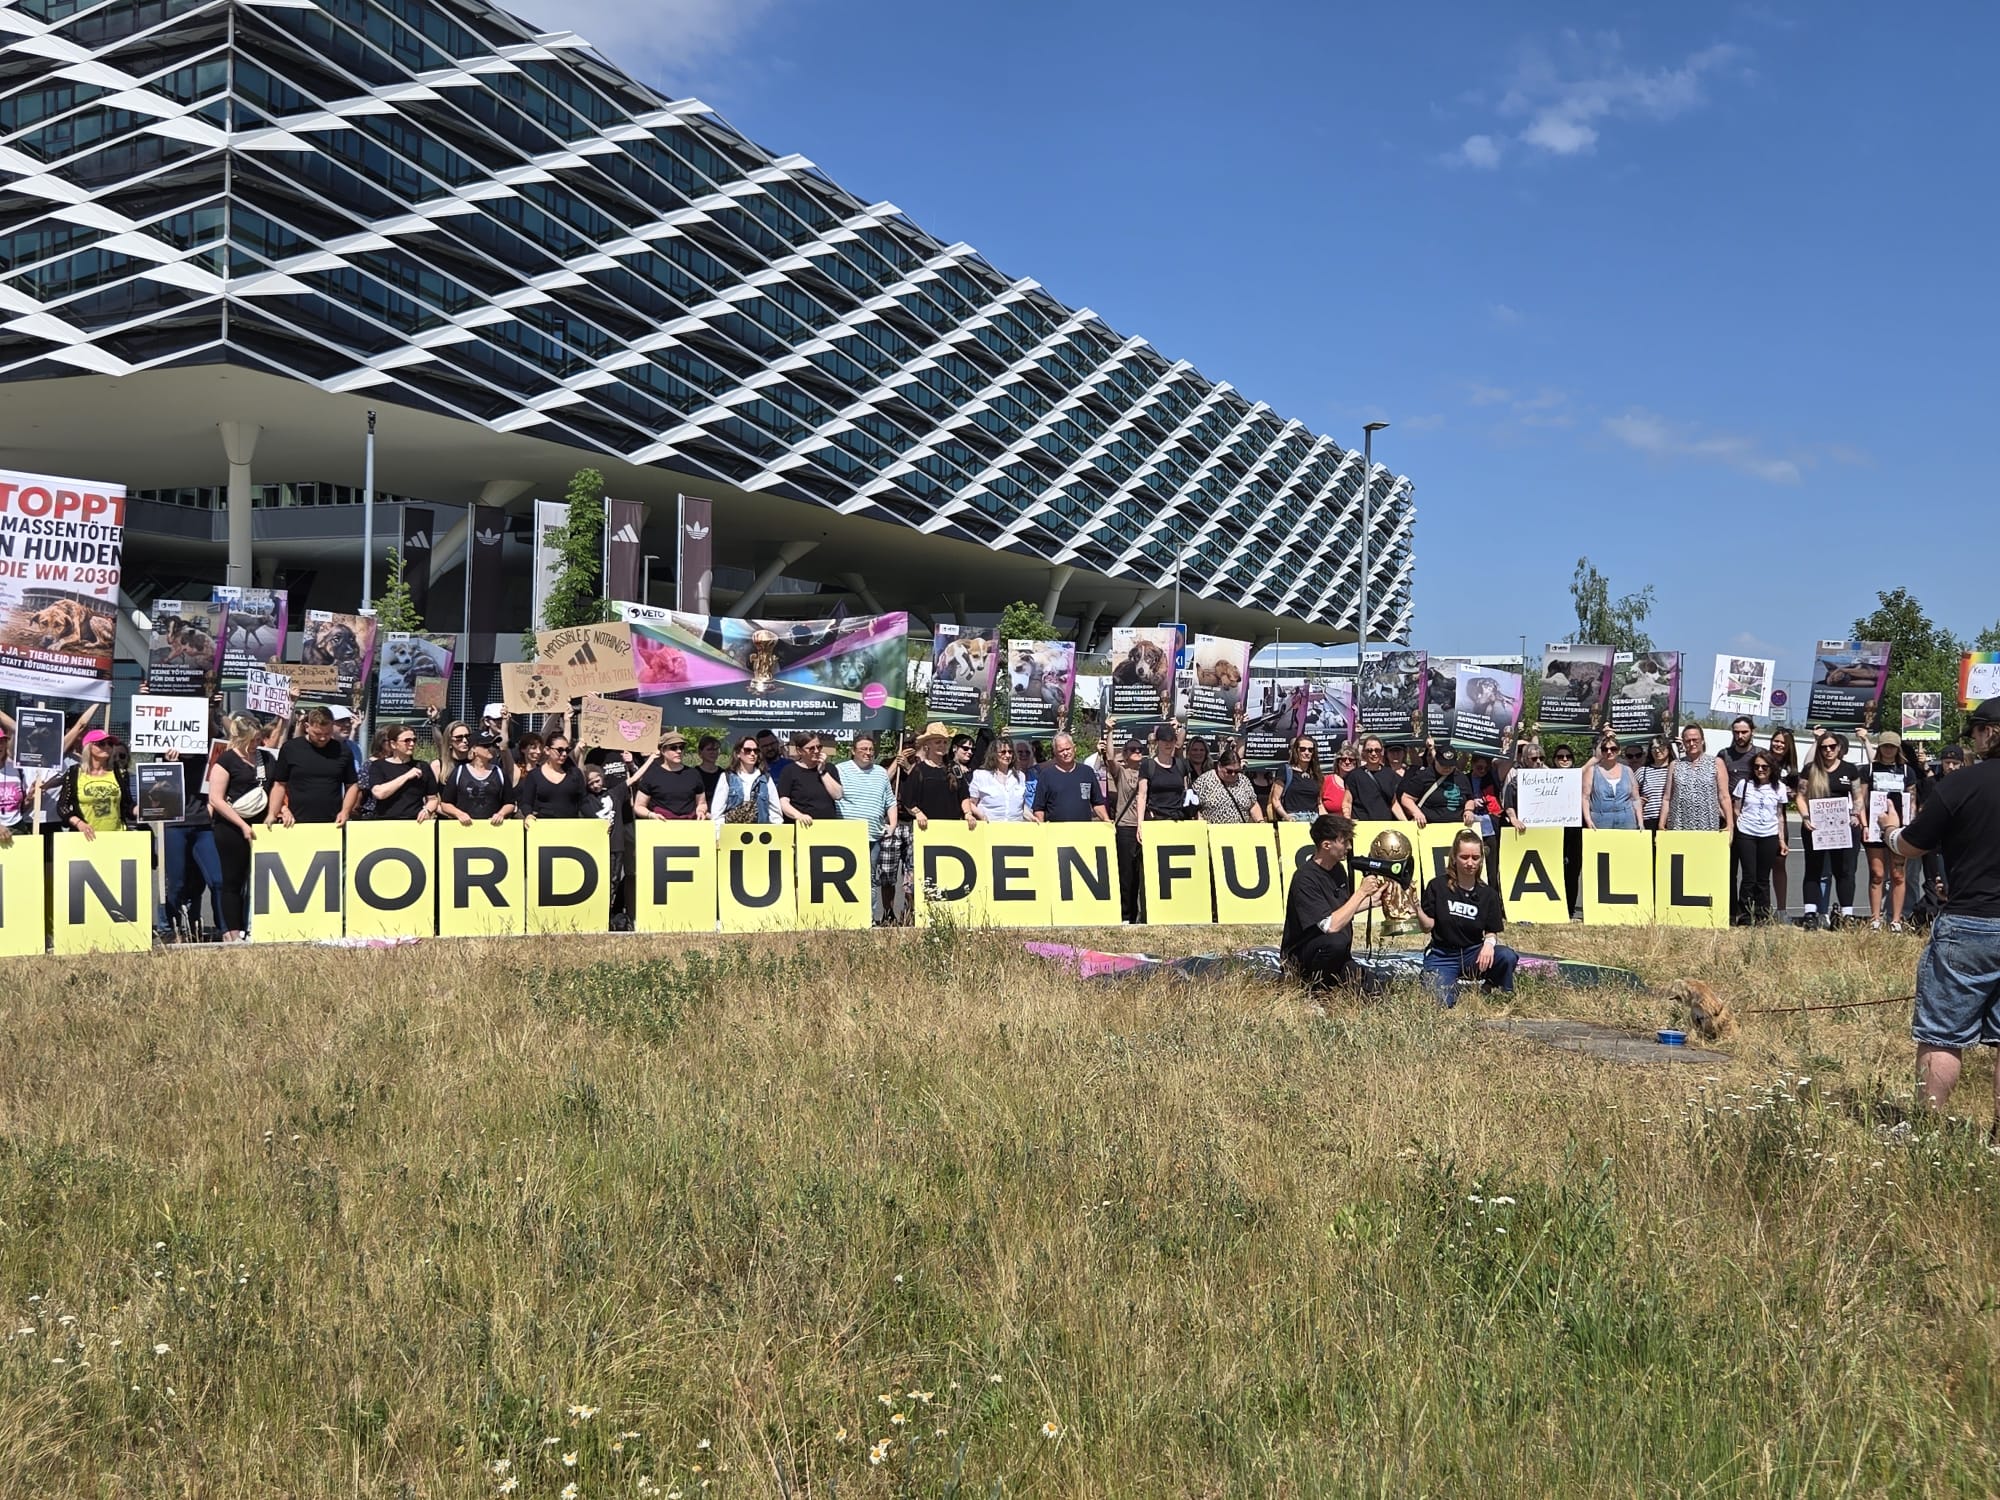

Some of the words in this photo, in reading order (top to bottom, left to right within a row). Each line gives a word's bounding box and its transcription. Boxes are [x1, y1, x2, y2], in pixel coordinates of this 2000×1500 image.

[35, 563, 69, 582] WM
[73, 566, 119, 586] 2030
[641, 608, 666, 618] VETO
[583, 628, 592, 641] IS
[6, 646, 19, 656] JA
[29, 649, 69, 664] TIERLEID
[70, 655, 97, 667] NEIN!
[684, 697, 691, 706] 3
[692, 697, 715, 706] MIO.
[716, 698, 748, 708] OPFER
[749, 697, 769, 708] FÜR
[769, 700, 790, 709] DEN
[790, 700, 839, 709] FUSSBALL
[135, 705, 173, 718] STOP
[153, 719, 201, 732] KILLING
[135, 733, 180, 748] STRAY
[254, 845, 599, 915] MORD
[652, 830, 859, 908] FÜR
[923, 844, 1112, 902] DEN
[1447, 899, 1478, 917] VETO
